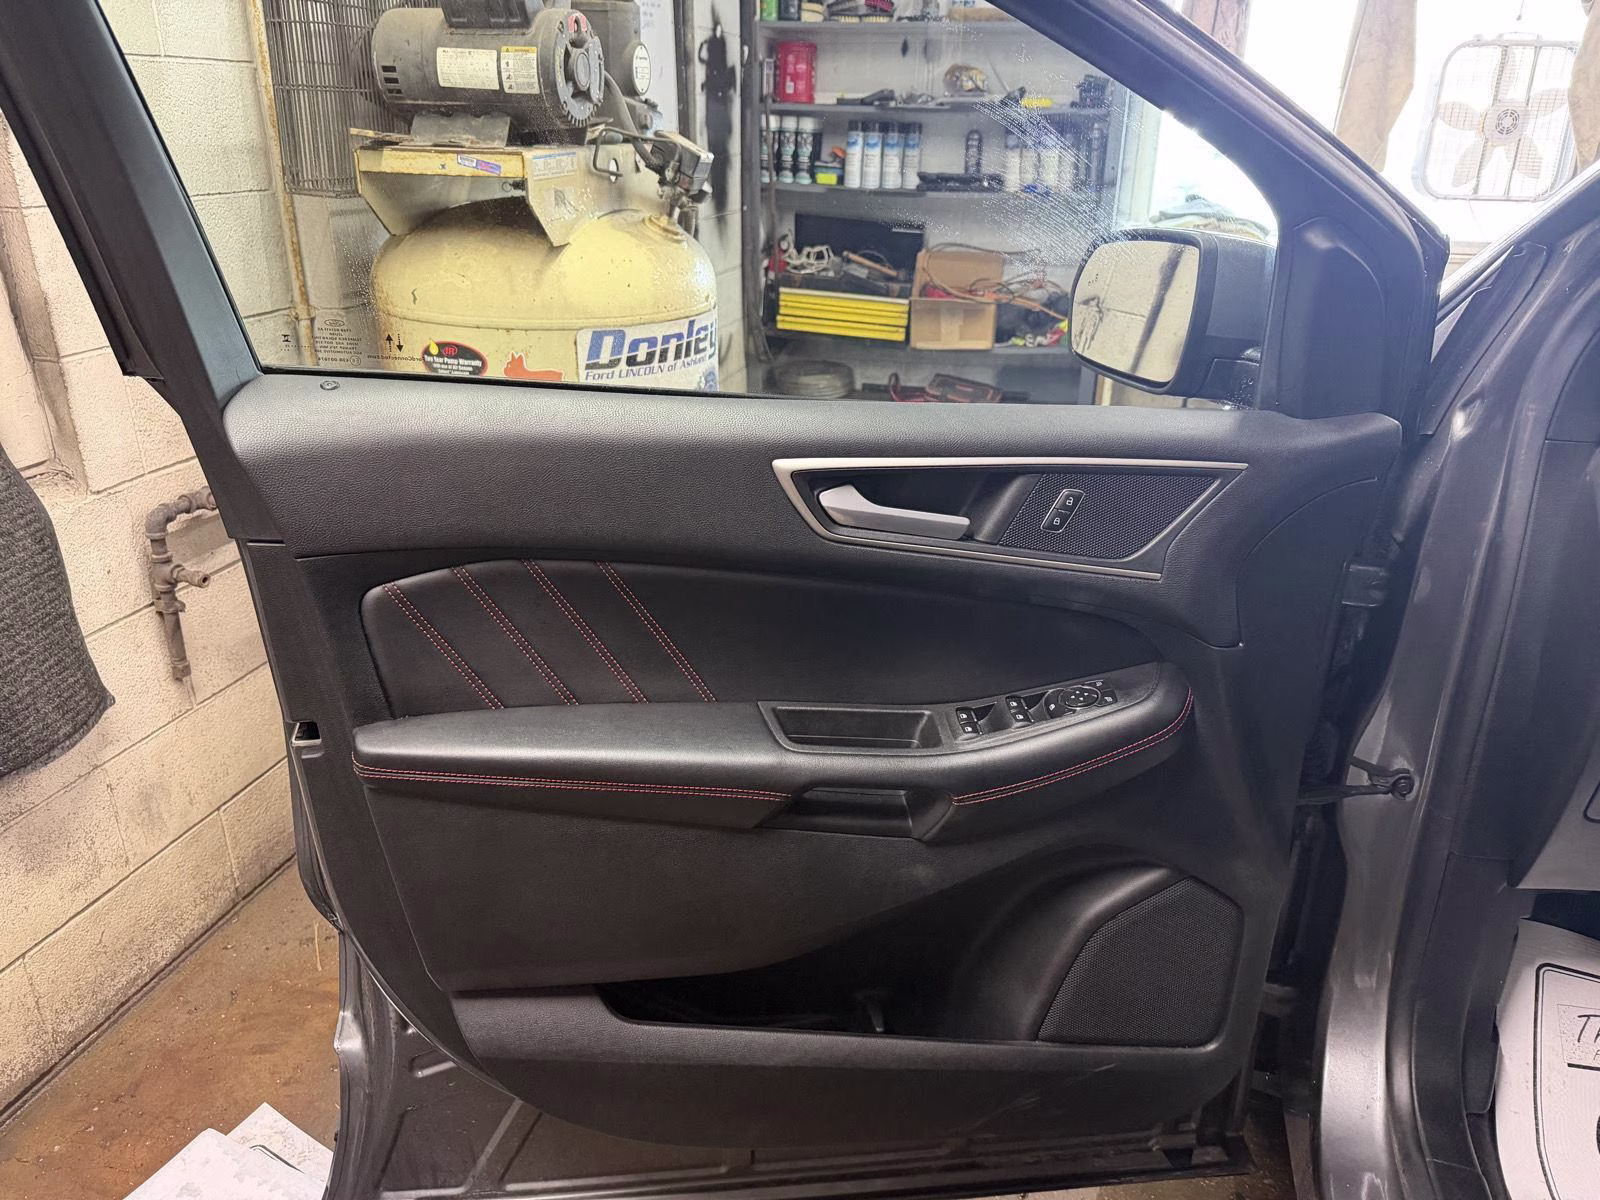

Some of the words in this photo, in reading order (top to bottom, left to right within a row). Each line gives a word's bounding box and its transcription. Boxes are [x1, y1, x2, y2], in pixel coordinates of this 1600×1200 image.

[585, 319, 717, 370] Donley
[458, 359, 482, 367] Warranty
[585, 370, 615, 381] Ford
[618, 364, 666, 379] LINCOLN
[667, 362, 678, 373] of
